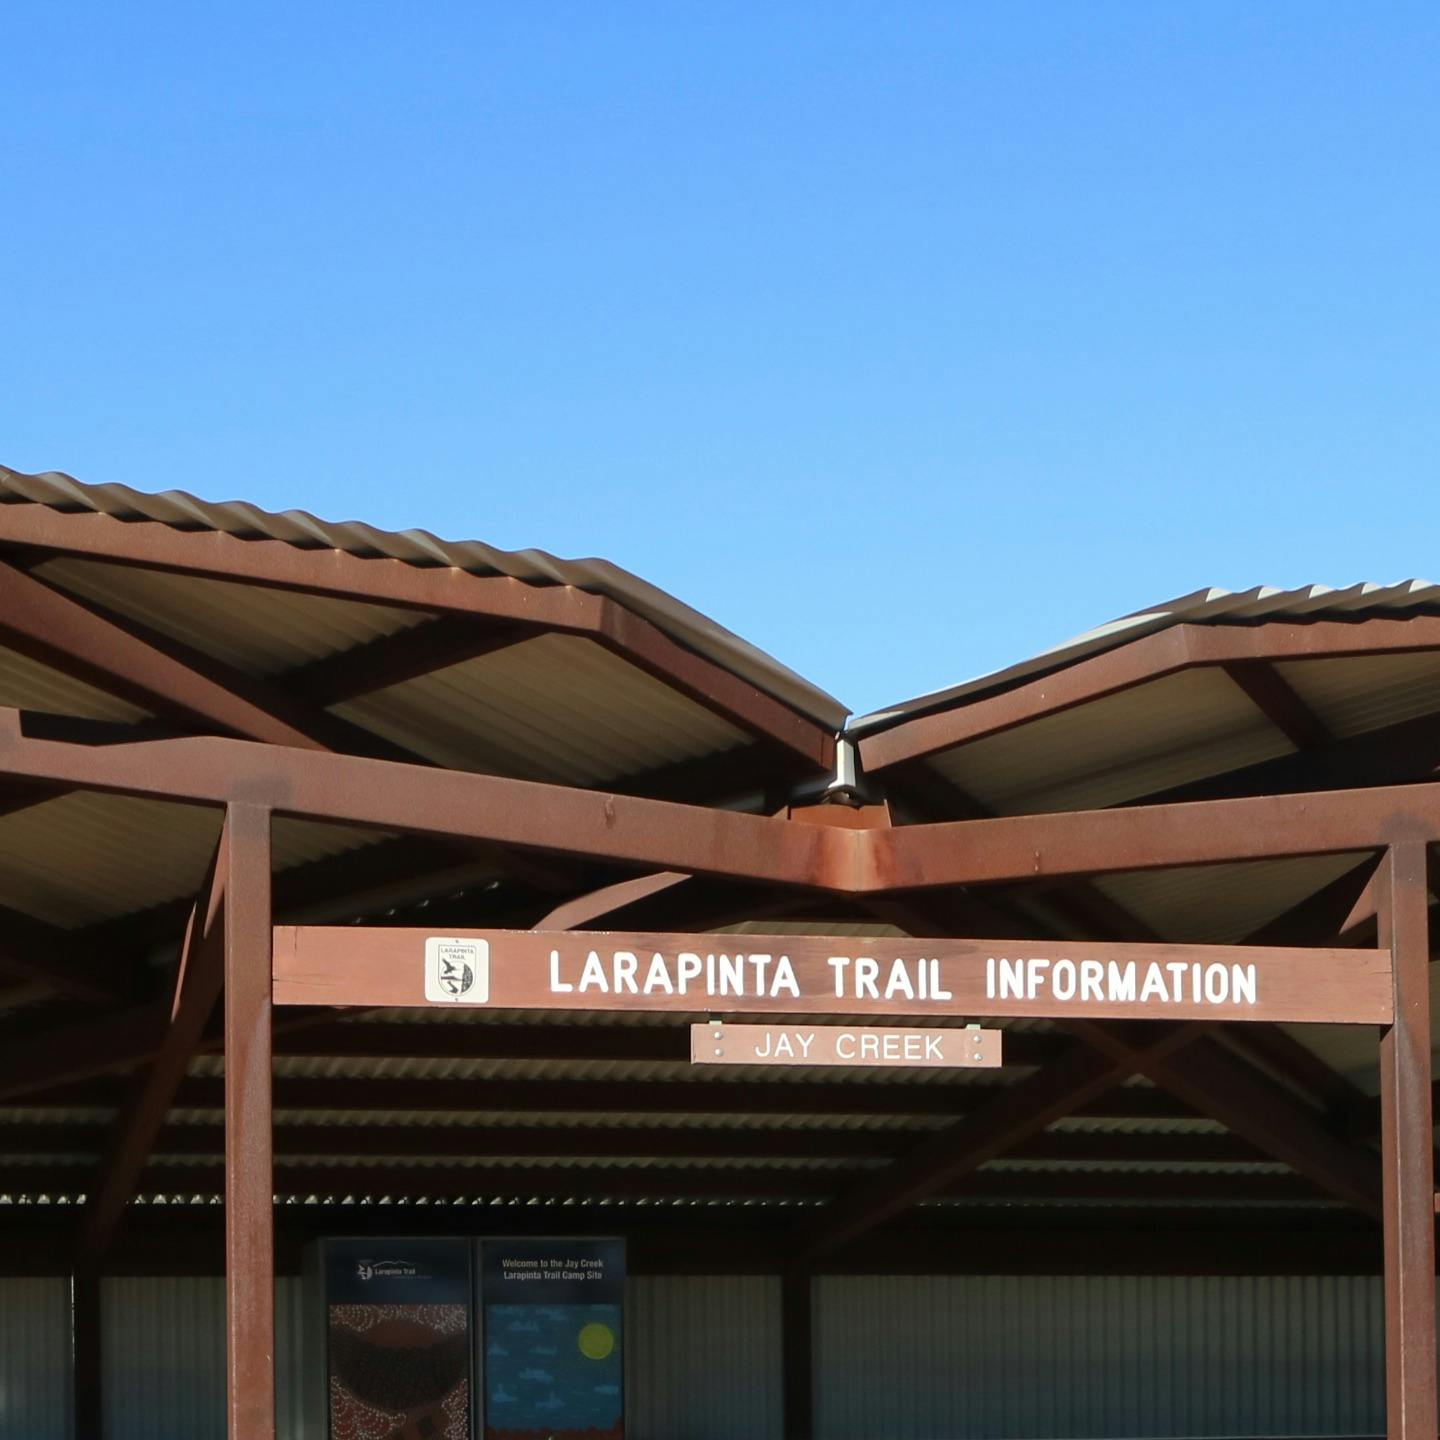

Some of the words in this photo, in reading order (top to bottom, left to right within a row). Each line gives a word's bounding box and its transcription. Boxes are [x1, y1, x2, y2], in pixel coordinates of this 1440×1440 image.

[549, 949, 801, 998] LARAPINTA
[827, 956, 953, 1001] TRAIL
[986, 958, 1257, 1006] INFORMATION
[755, 1032, 814, 1058] JAY
[835, 1033, 944, 1060] CREEK
[502, 1259, 538, 1268] Welcome
[540, 1259, 548, 1268] to
[550, 1259, 563, 1268] the
[564, 1259, 579, 1270] Jay
[580, 1259, 604, 1269] Creek
[503, 1271, 542, 1281] Larapinta
[544, 1271, 561, 1280] Trail
[562, 1271, 586, 1281] Camp
[587, 1271, 603, 1280] Site
